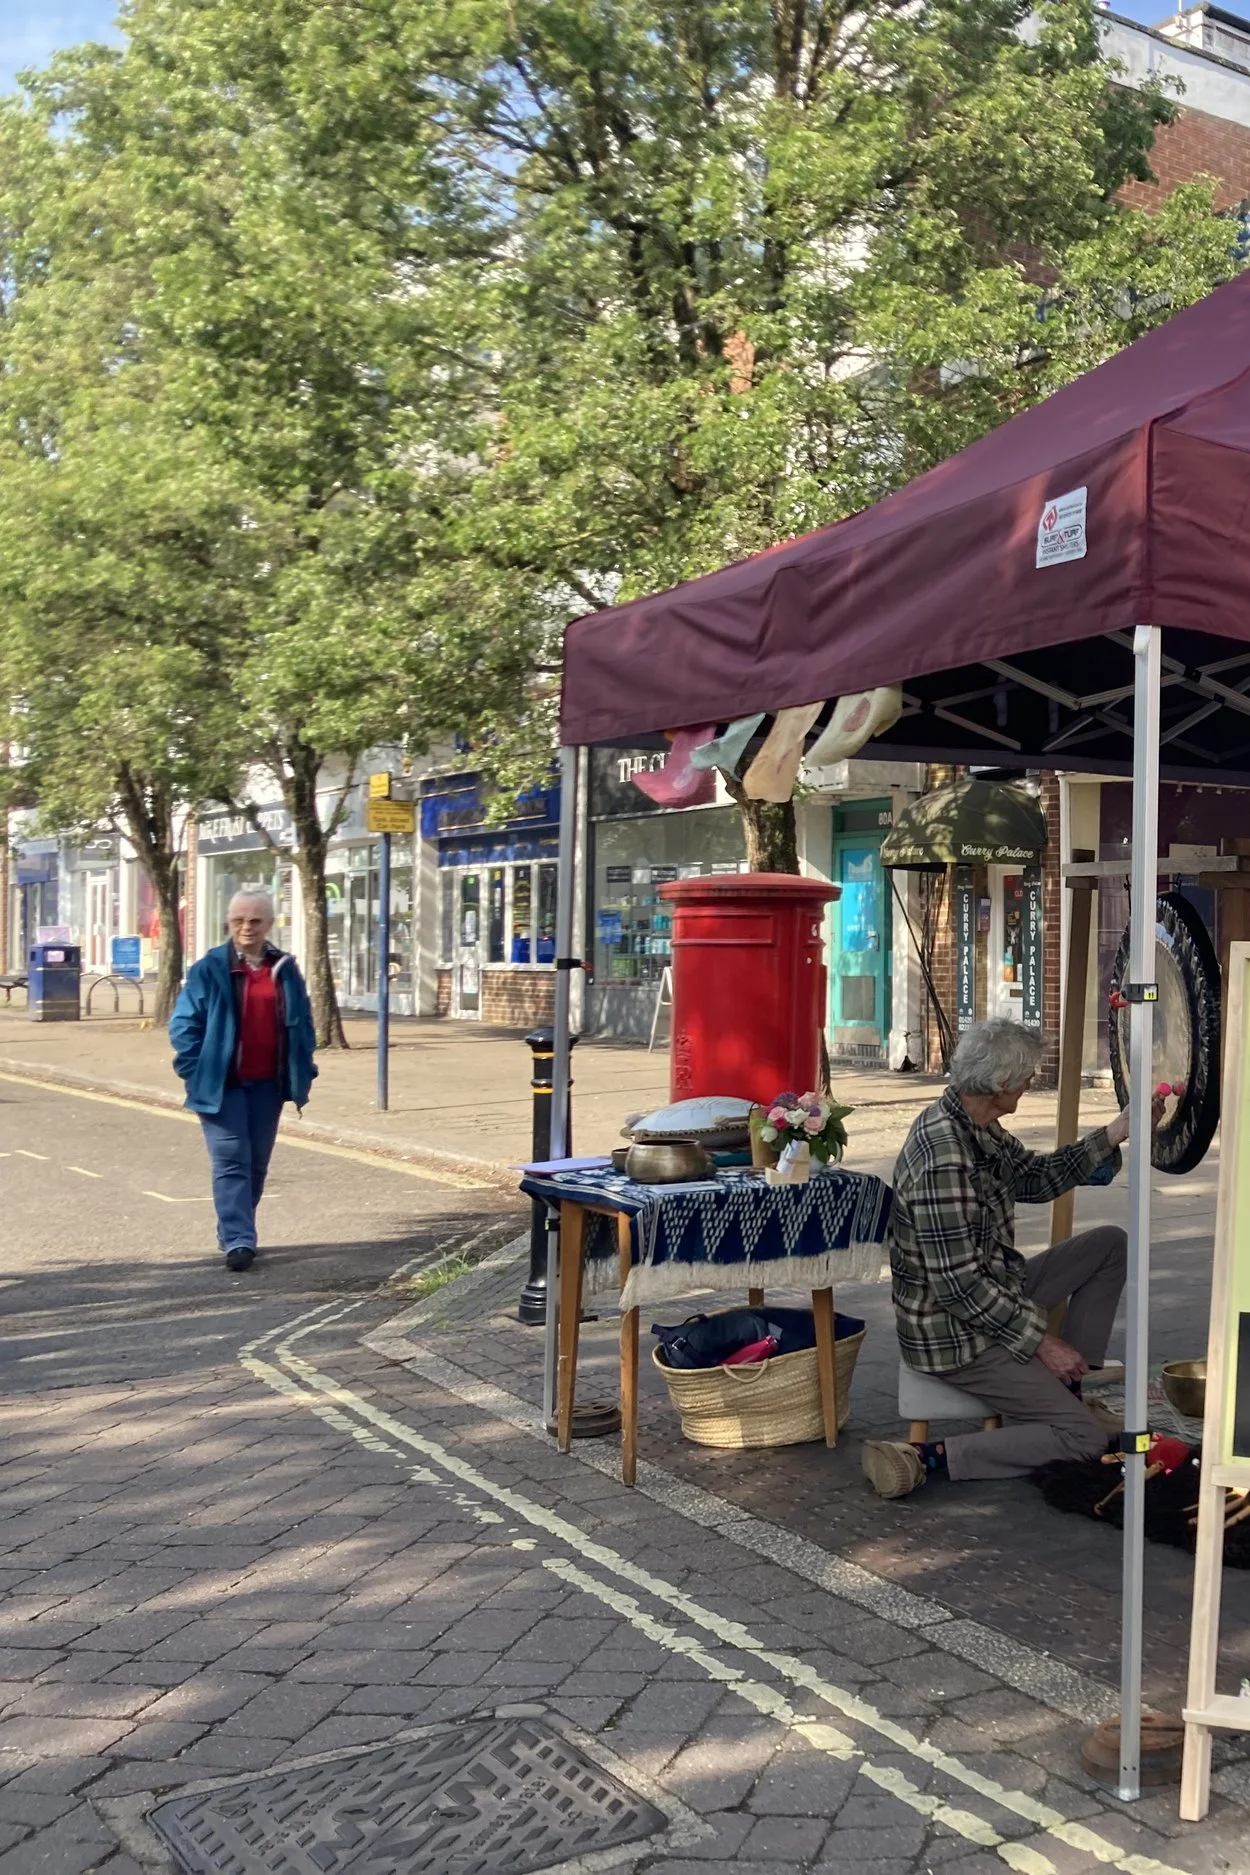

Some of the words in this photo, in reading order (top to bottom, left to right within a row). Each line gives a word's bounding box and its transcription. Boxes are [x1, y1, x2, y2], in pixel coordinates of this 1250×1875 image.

[961, 844, 994, 861] Curry
[995, 845, 1035, 859] Palace
[1029, 890, 1037, 941] CURRY
